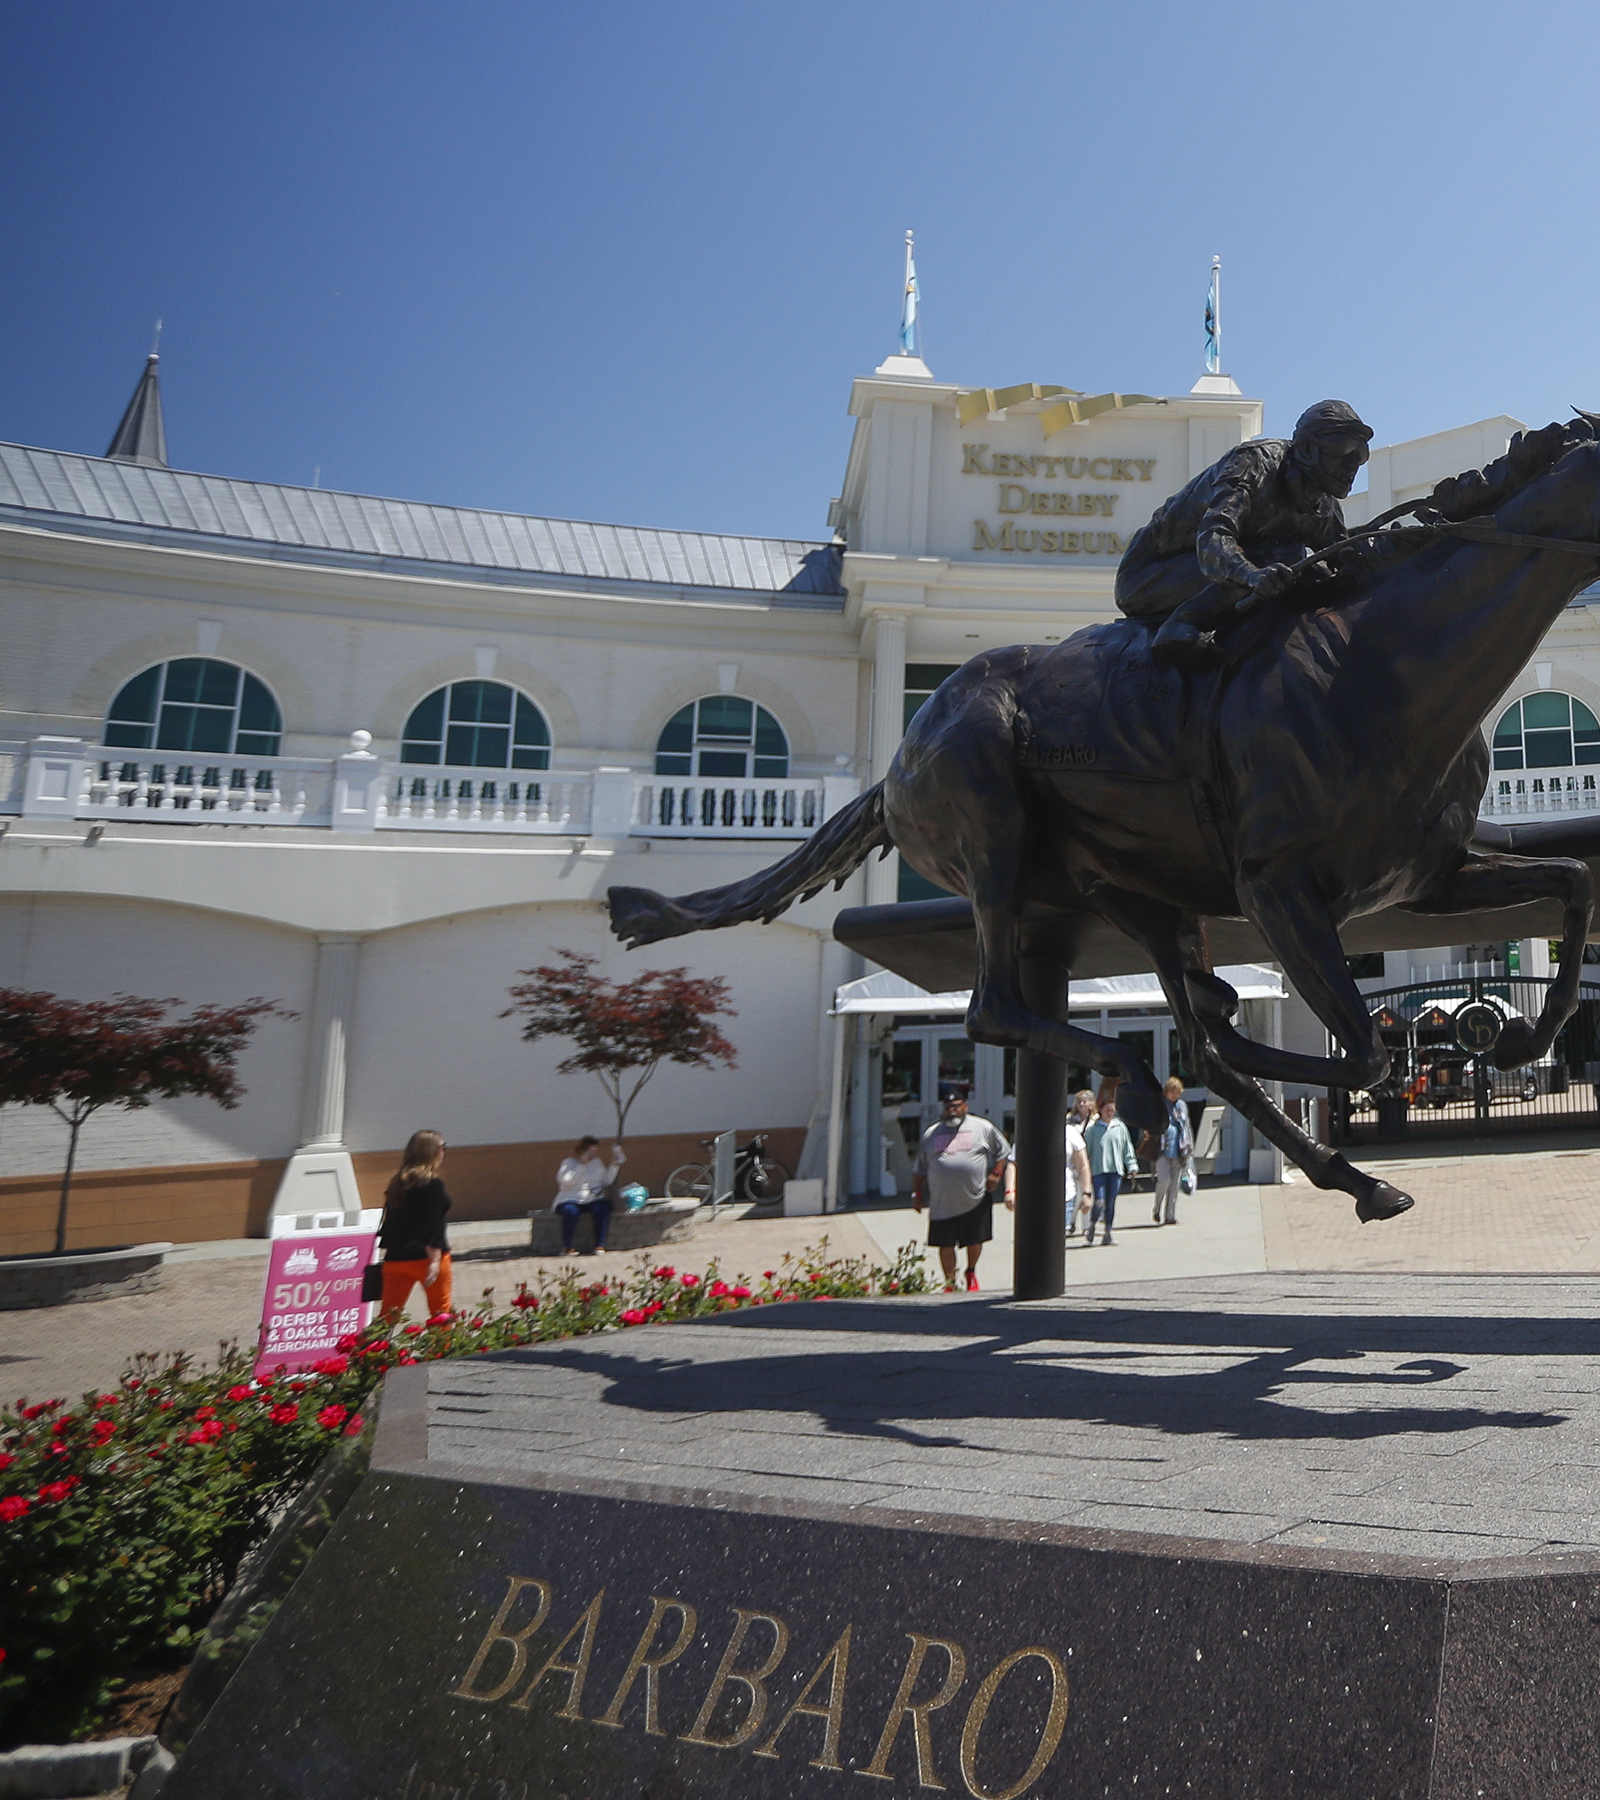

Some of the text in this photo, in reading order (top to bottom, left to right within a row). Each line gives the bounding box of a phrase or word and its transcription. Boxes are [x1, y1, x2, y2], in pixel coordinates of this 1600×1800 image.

[961, 442, 1158, 481] KENTUCKY
[998, 482, 1119, 517] DERBY
[273, 1277, 363, 1309] 50% OFF
[266, 1321, 359, 1342] & OAKS 145
[269, 1307, 360, 1329] DERBY 145
[264, 1336, 341, 1353] MERCHAND
[448, 1575, 1069, 1800] BARBARO
